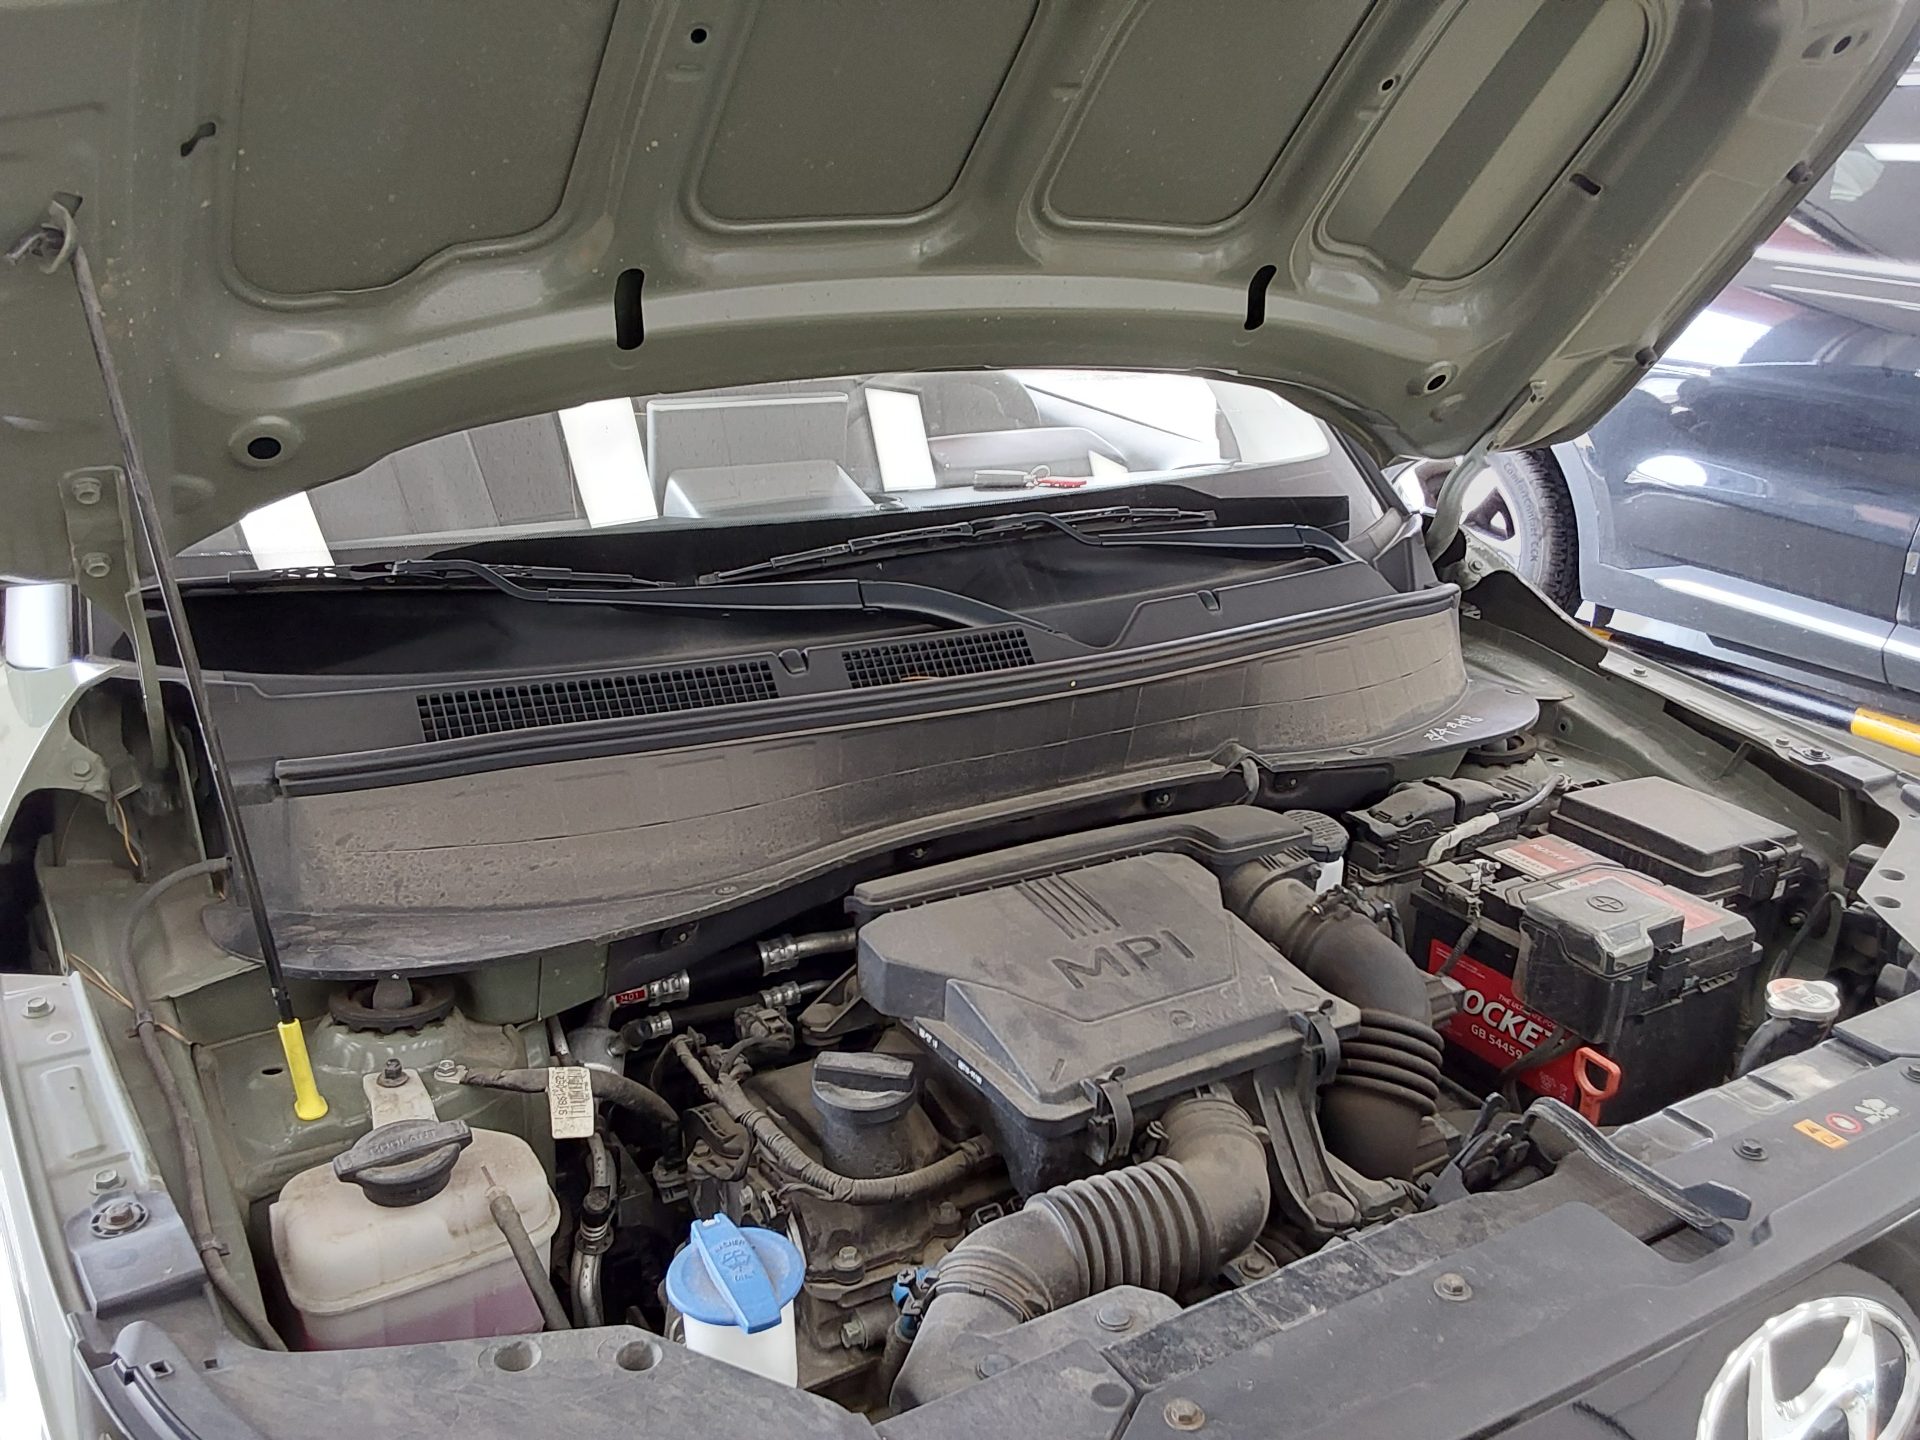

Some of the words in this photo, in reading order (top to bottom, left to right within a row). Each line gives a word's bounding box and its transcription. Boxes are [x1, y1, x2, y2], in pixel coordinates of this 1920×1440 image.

[1050, 929, 1195, 989] MPI
[1471, 1024, 1487, 1040] GB
[1488, 1035, 1524, 1061] 54459
